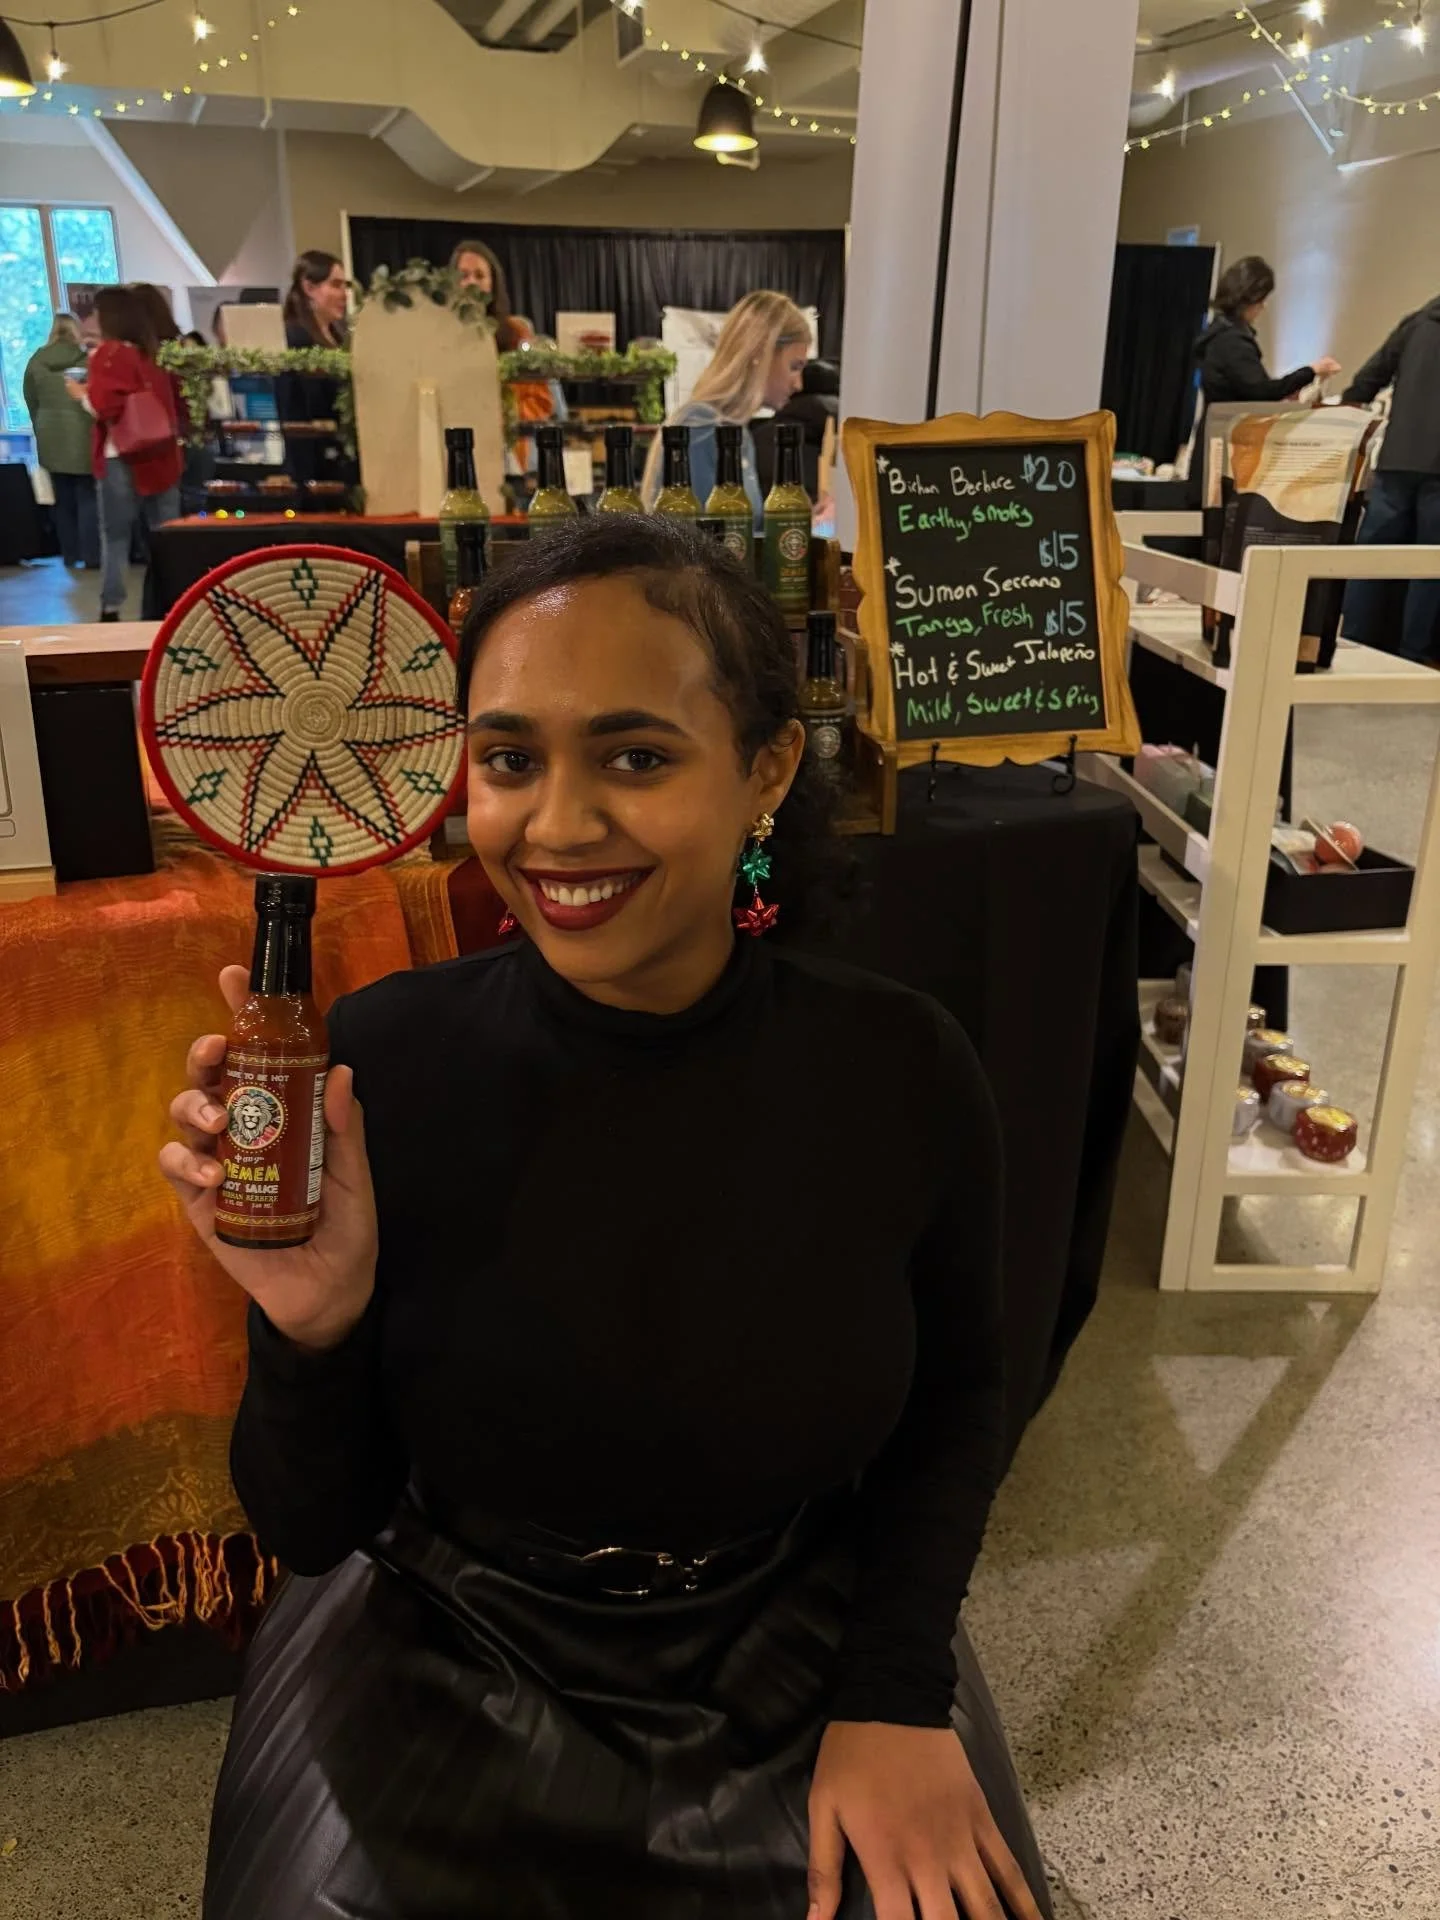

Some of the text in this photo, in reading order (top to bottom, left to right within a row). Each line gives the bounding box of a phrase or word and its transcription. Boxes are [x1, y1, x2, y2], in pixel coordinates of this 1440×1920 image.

[1019, 453, 1077, 492] $20
[1038, 530, 1080, 571] $15
[983, 566, 1062, 598] Serrano
[981, 601, 1034, 630] Fresh
[1044, 600, 1087, 637] $15
[894, 655, 939, 690] Hot
[270, 1074, 290, 1082] HOT
